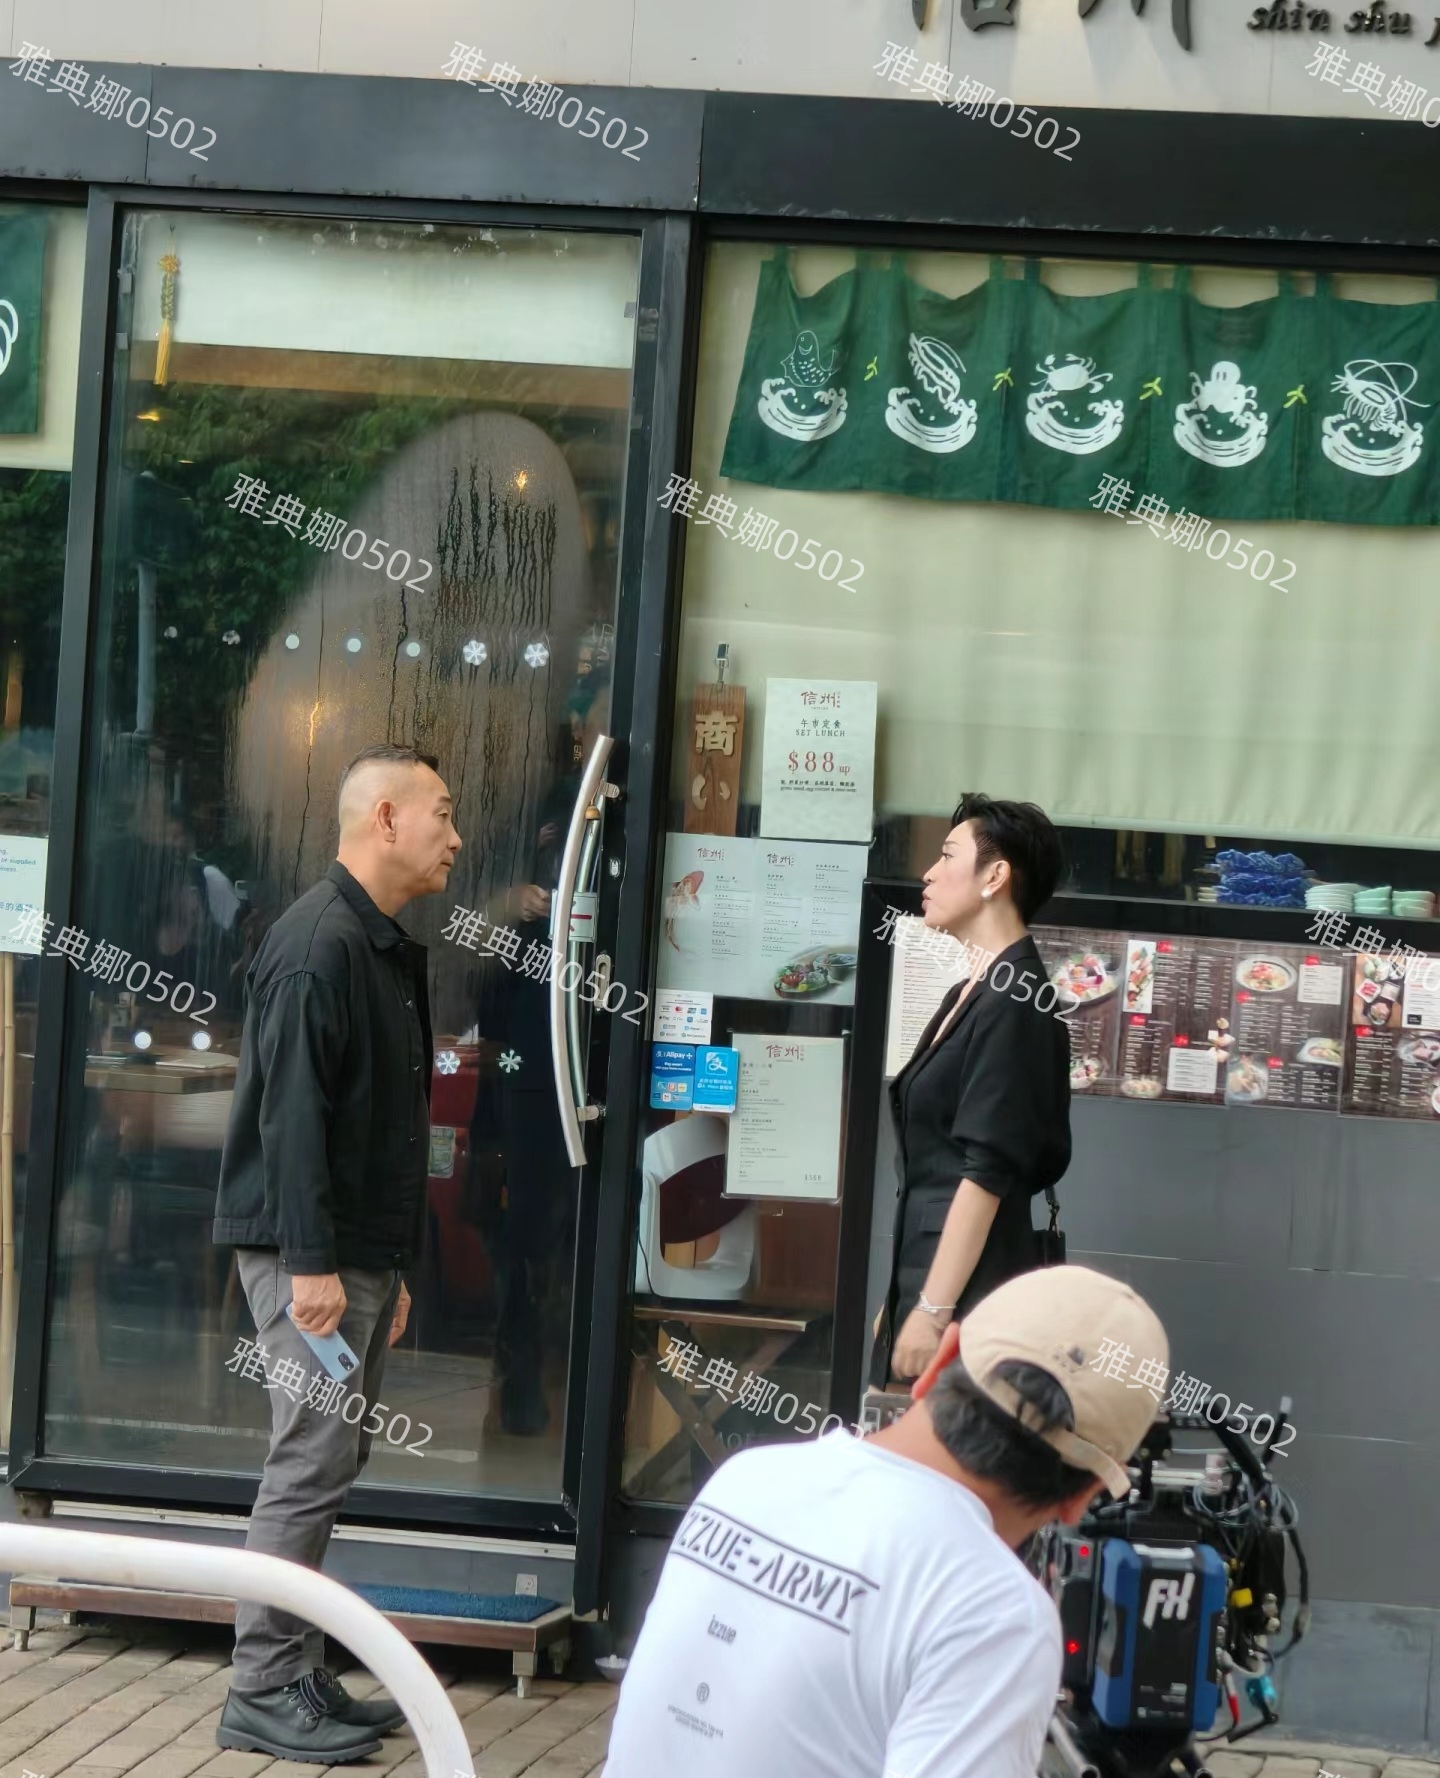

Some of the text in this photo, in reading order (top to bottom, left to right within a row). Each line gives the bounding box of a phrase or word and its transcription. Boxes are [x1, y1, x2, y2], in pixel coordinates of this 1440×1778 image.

[1247, 0, 1331, 31] shin
[1343, 0, 1412, 35] shu
[801, 690, 836, 708] 信州
[795, 729, 811, 737] SET
[788, 749, 851, 776] $88 up
[766, 1044, 800, 1060] 信州
